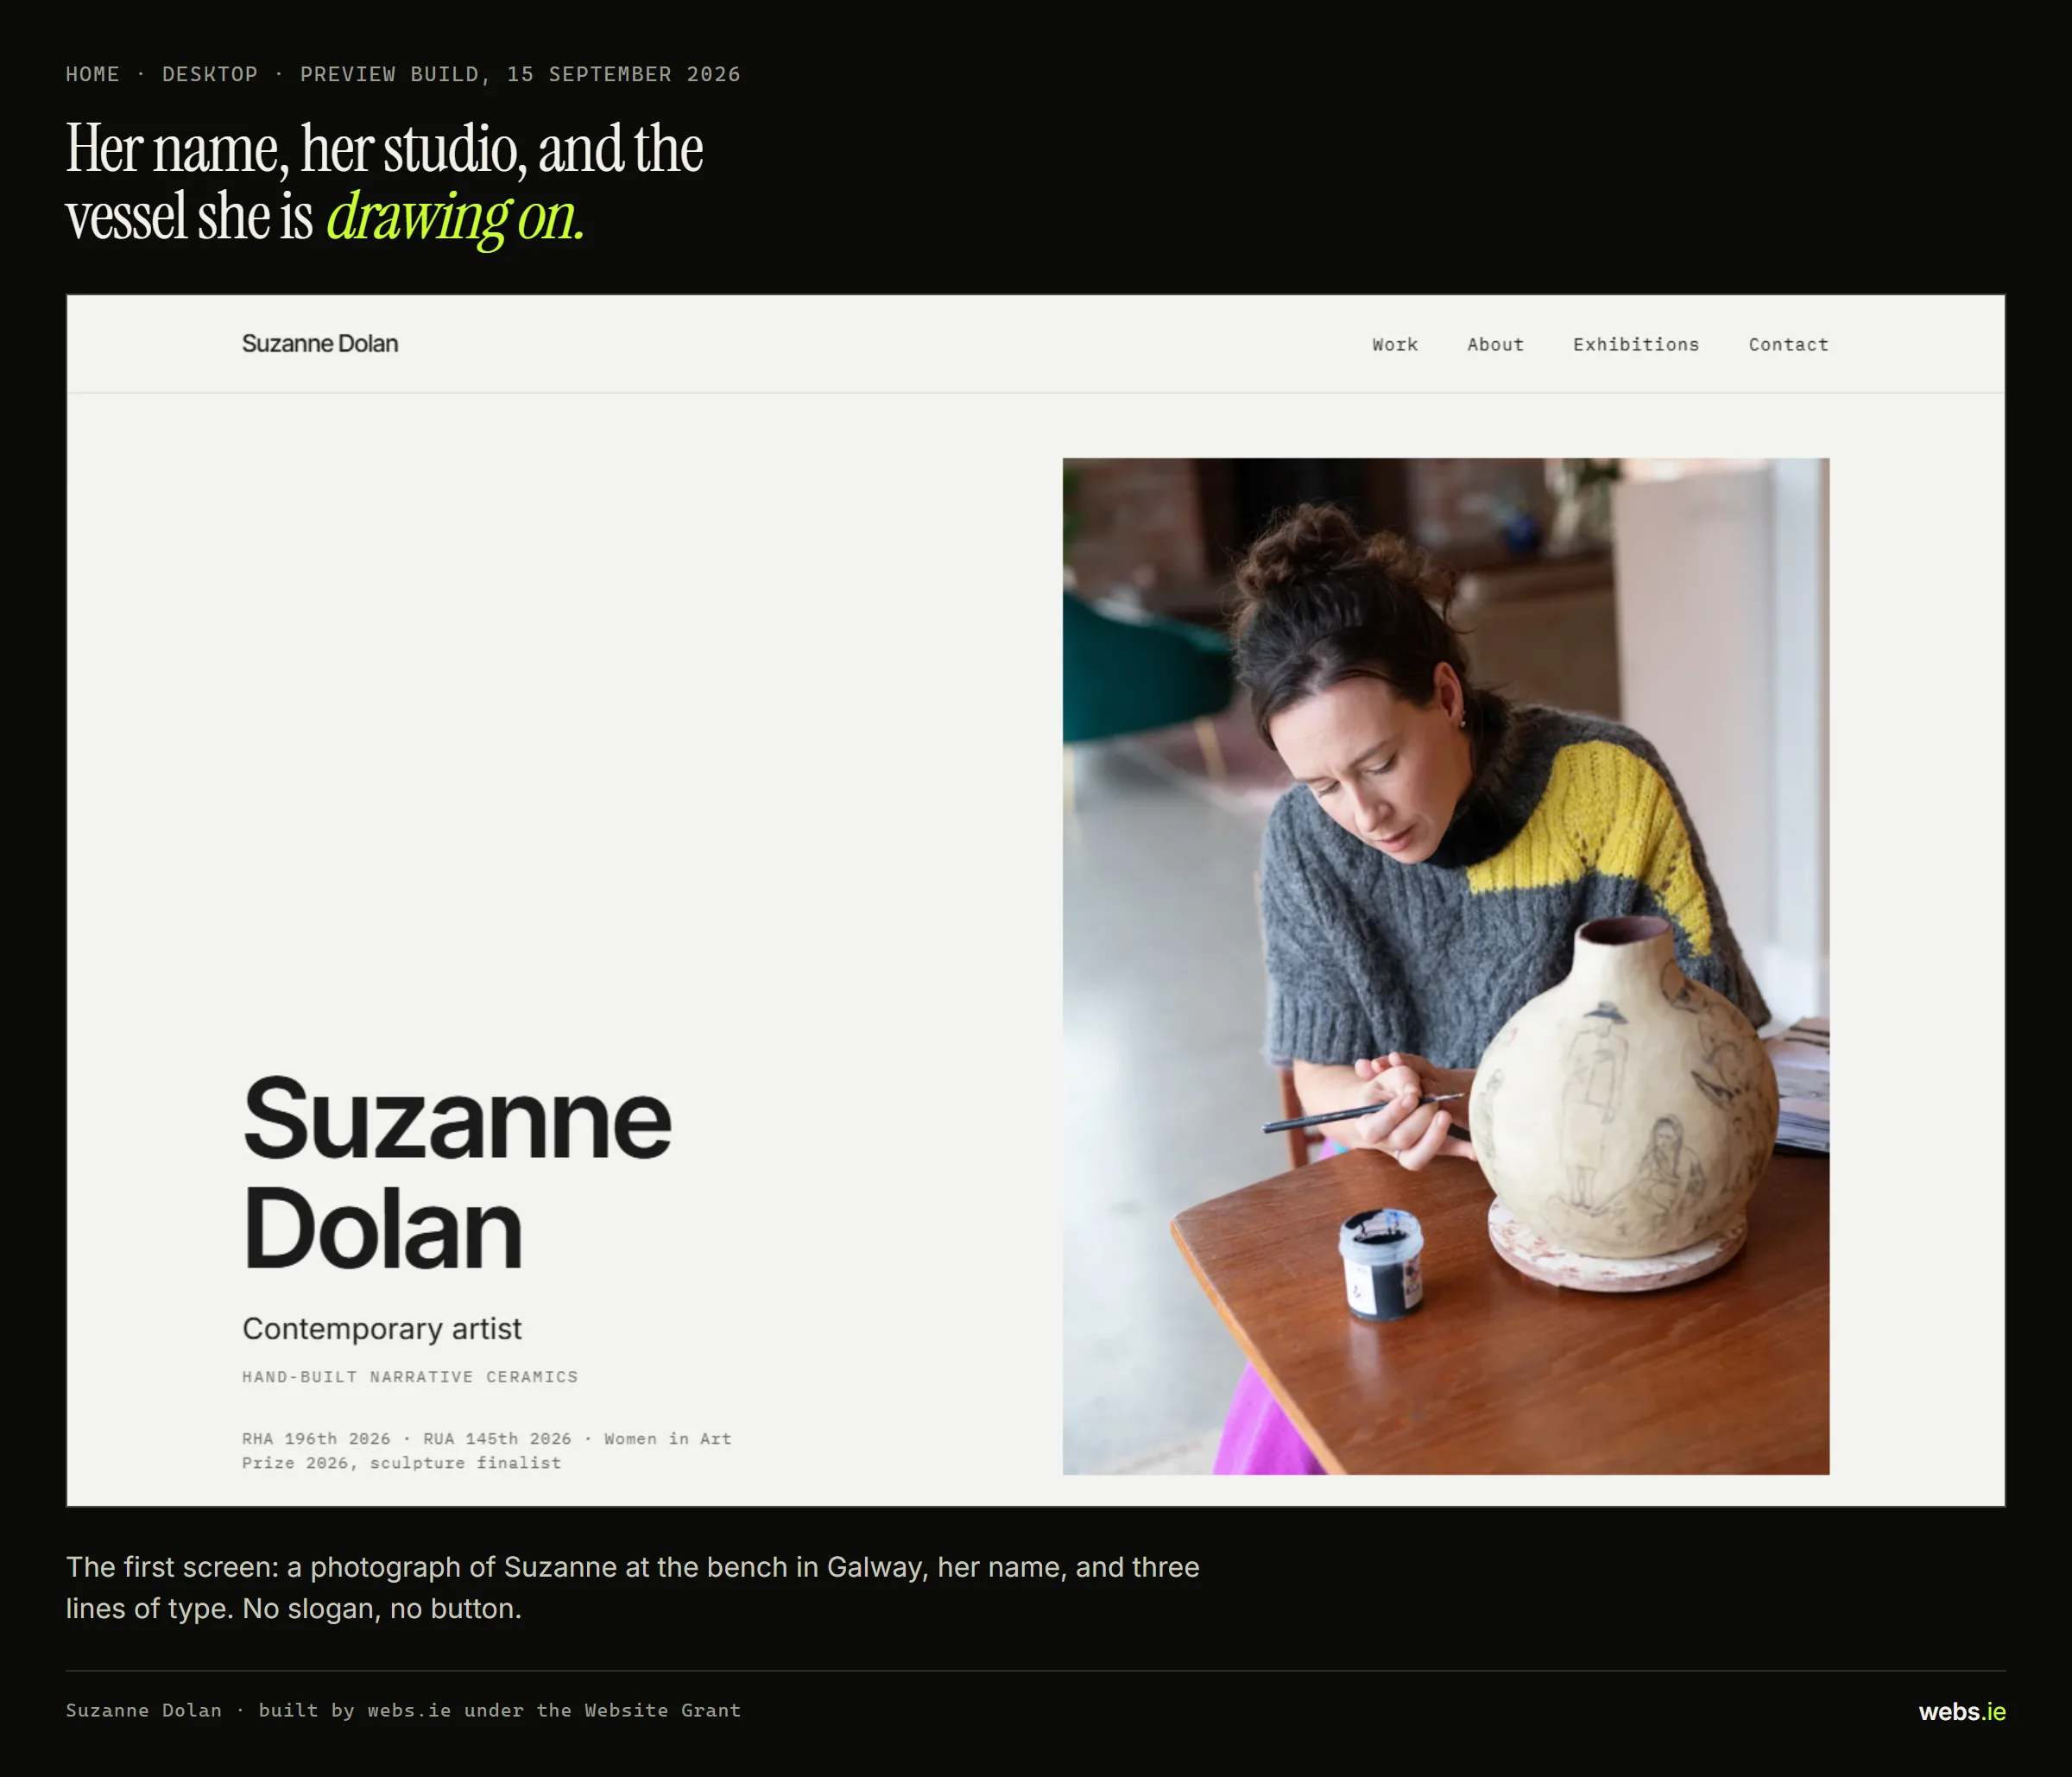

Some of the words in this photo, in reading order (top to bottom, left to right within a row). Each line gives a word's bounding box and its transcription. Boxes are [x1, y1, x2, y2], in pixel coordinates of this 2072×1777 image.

[242, 333, 335, 353] Suzanne
[338, 333, 400, 353] Dolan
[1372, 336, 1418, 351] Work
[1467, 336, 1525, 351] About
[1574, 336, 1699, 351] Exhibitions
[1749, 337, 1829, 351] Contact
[243, 1074, 673, 1160] Suzanne
[246, 1186, 522, 1270] Dolan
[243, 1316, 444, 1347] Contemporary
[452, 1315, 523, 1340] artist
[243, 1370, 357, 1383] HAND-BUILT
[370, 1370, 472, 1383] NARRATIVE
[486, 1370, 578, 1383] CERAMICS
[243, 1432, 274, 1445] RHA
[285, 1431, 338, 1445] 196th
[349, 1432, 391, 1445] 2026
[424, 1432, 455, 1445] RUA
[466, 1431, 518, 1445] 145th
[529, 1432, 572, 1445] 2026
[604, 1432, 657, 1445] Women
[669, 1431, 689, 1445] in
[699, 1432, 732, 1445] Art
[243, 1455, 294, 1470] Prize
[306, 1457, 357, 1472] 2026,
[370, 1455, 465, 1472] sculpture
[477, 1455, 561, 1470] finalist
